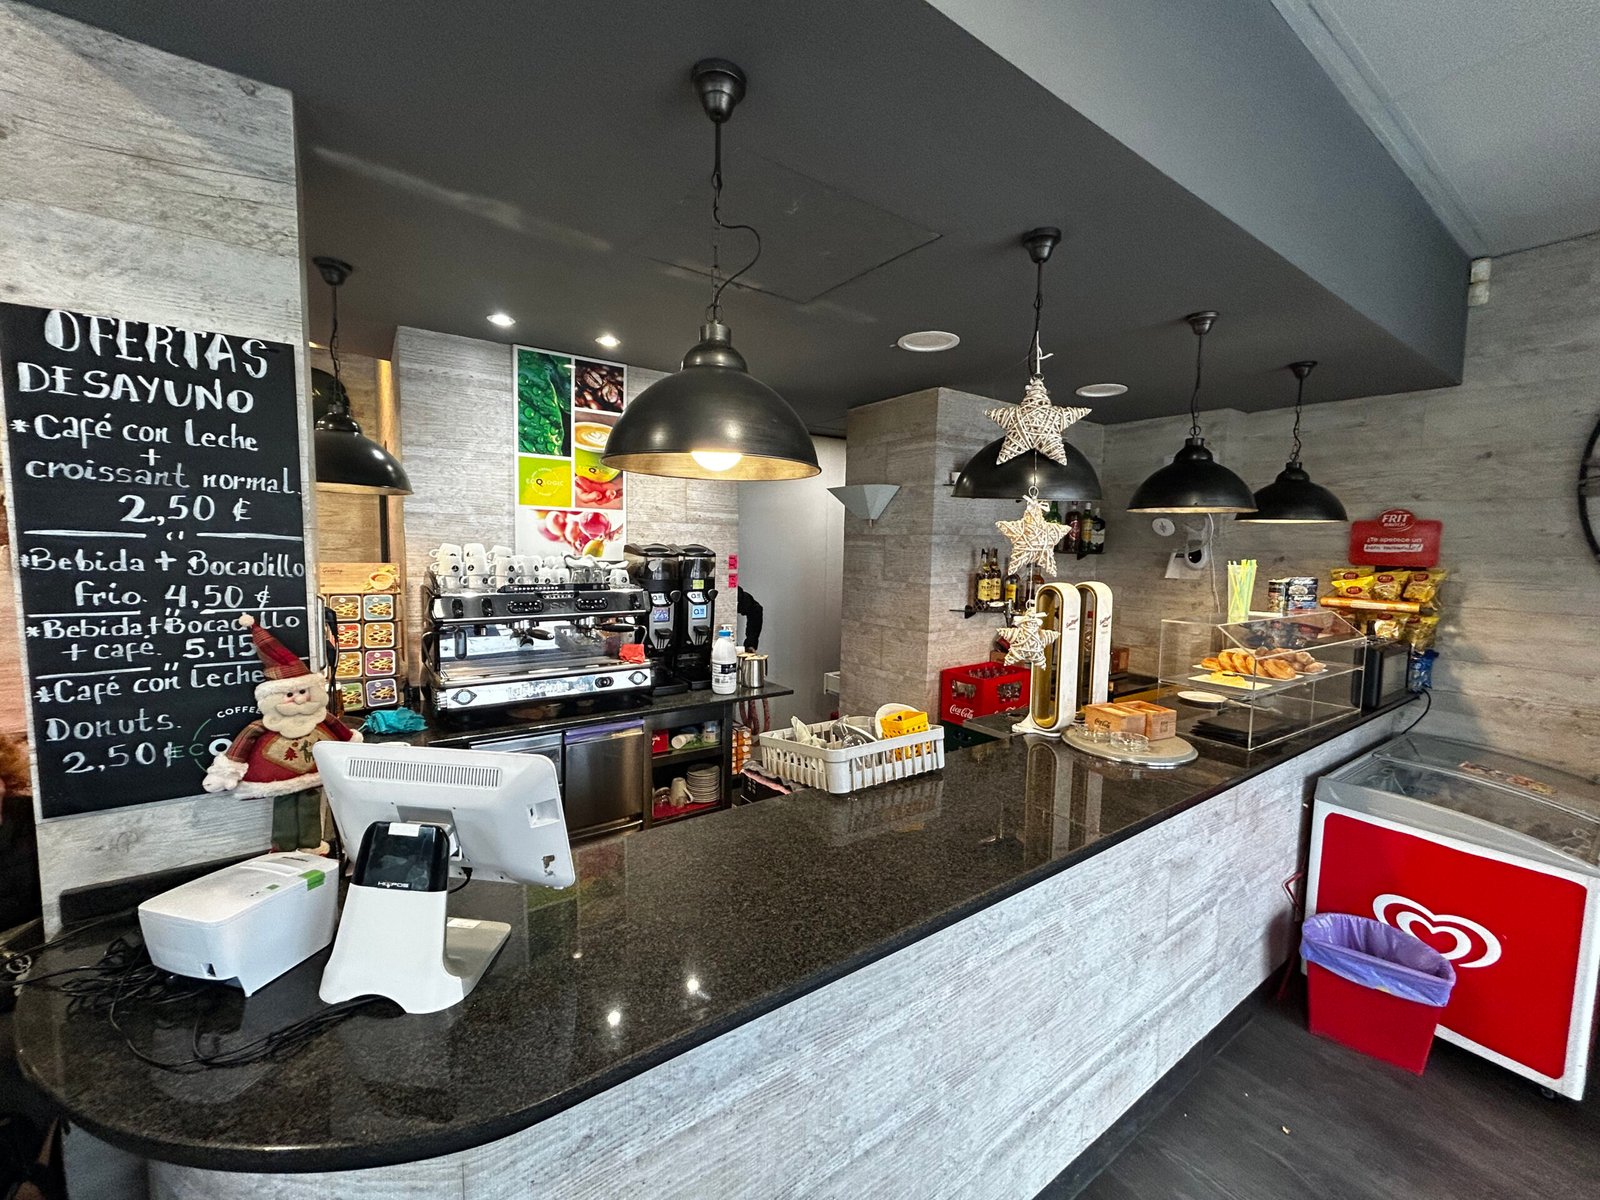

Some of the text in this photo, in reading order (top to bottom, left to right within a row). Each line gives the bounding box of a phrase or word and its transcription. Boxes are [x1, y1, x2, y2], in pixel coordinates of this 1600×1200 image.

[44, 309, 269, 379] OFERTAS
[17, 361, 255, 414] DESAYUNO
[122, 424, 172, 444] con
[25, 459, 191, 489] croissant
[118, 494, 216, 526] 2,50
[1382, 514, 1411, 523] FRIT
[187, 550, 305, 578] Bocadillo
[164, 584, 244, 609] 4,50
[163, 610, 301, 635] Bocadllo
[182, 634, 257, 659] 5,45
[132, 674, 182, 695] con
[62, 742, 157, 774] 2,50
